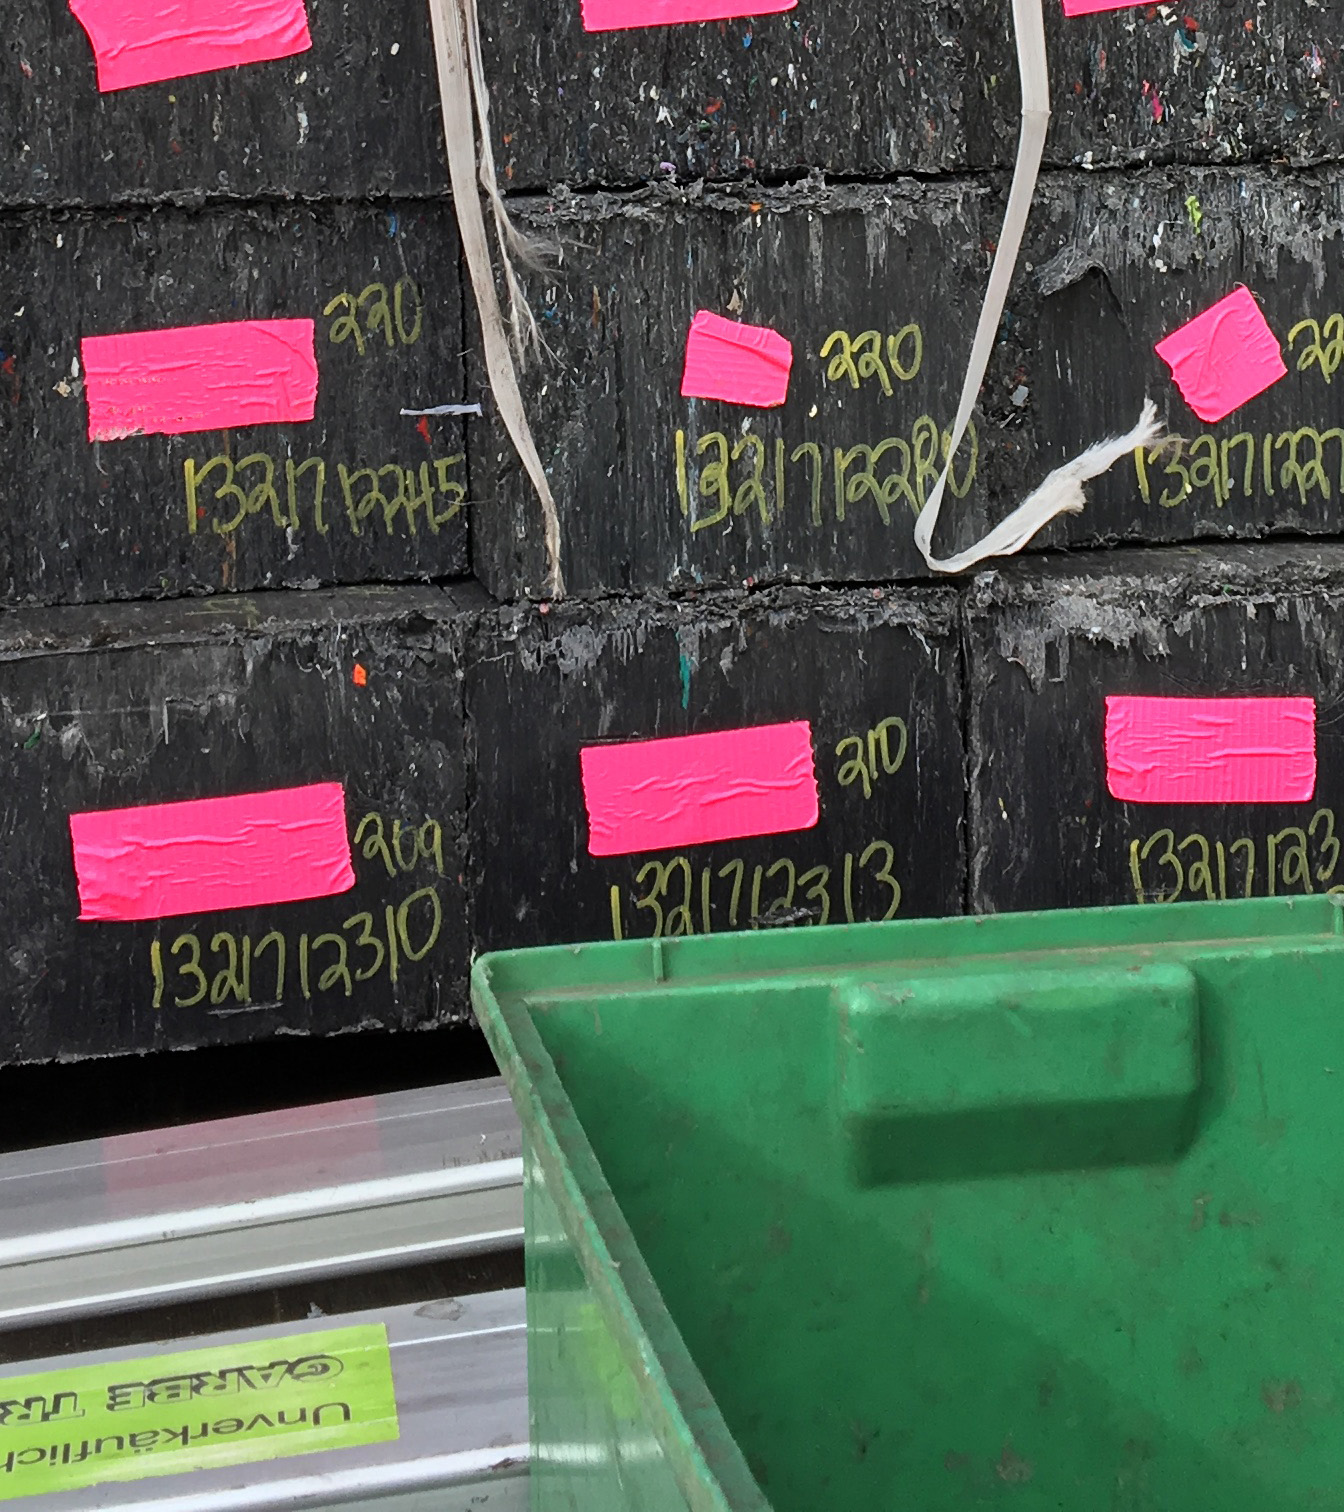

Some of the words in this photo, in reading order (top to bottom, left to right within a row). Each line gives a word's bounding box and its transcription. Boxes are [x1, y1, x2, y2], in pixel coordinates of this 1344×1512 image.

[323, 274, 423, 356] 220
[820, 324, 923, 397] 220
[184, 453, 467, 536] 1321712245
[835, 716, 908, 800] 210
[354, 811, 449, 878] 209
[151, 886, 443, 1008] 1321712310
[106, 1354, 345, 1412] GARBE
